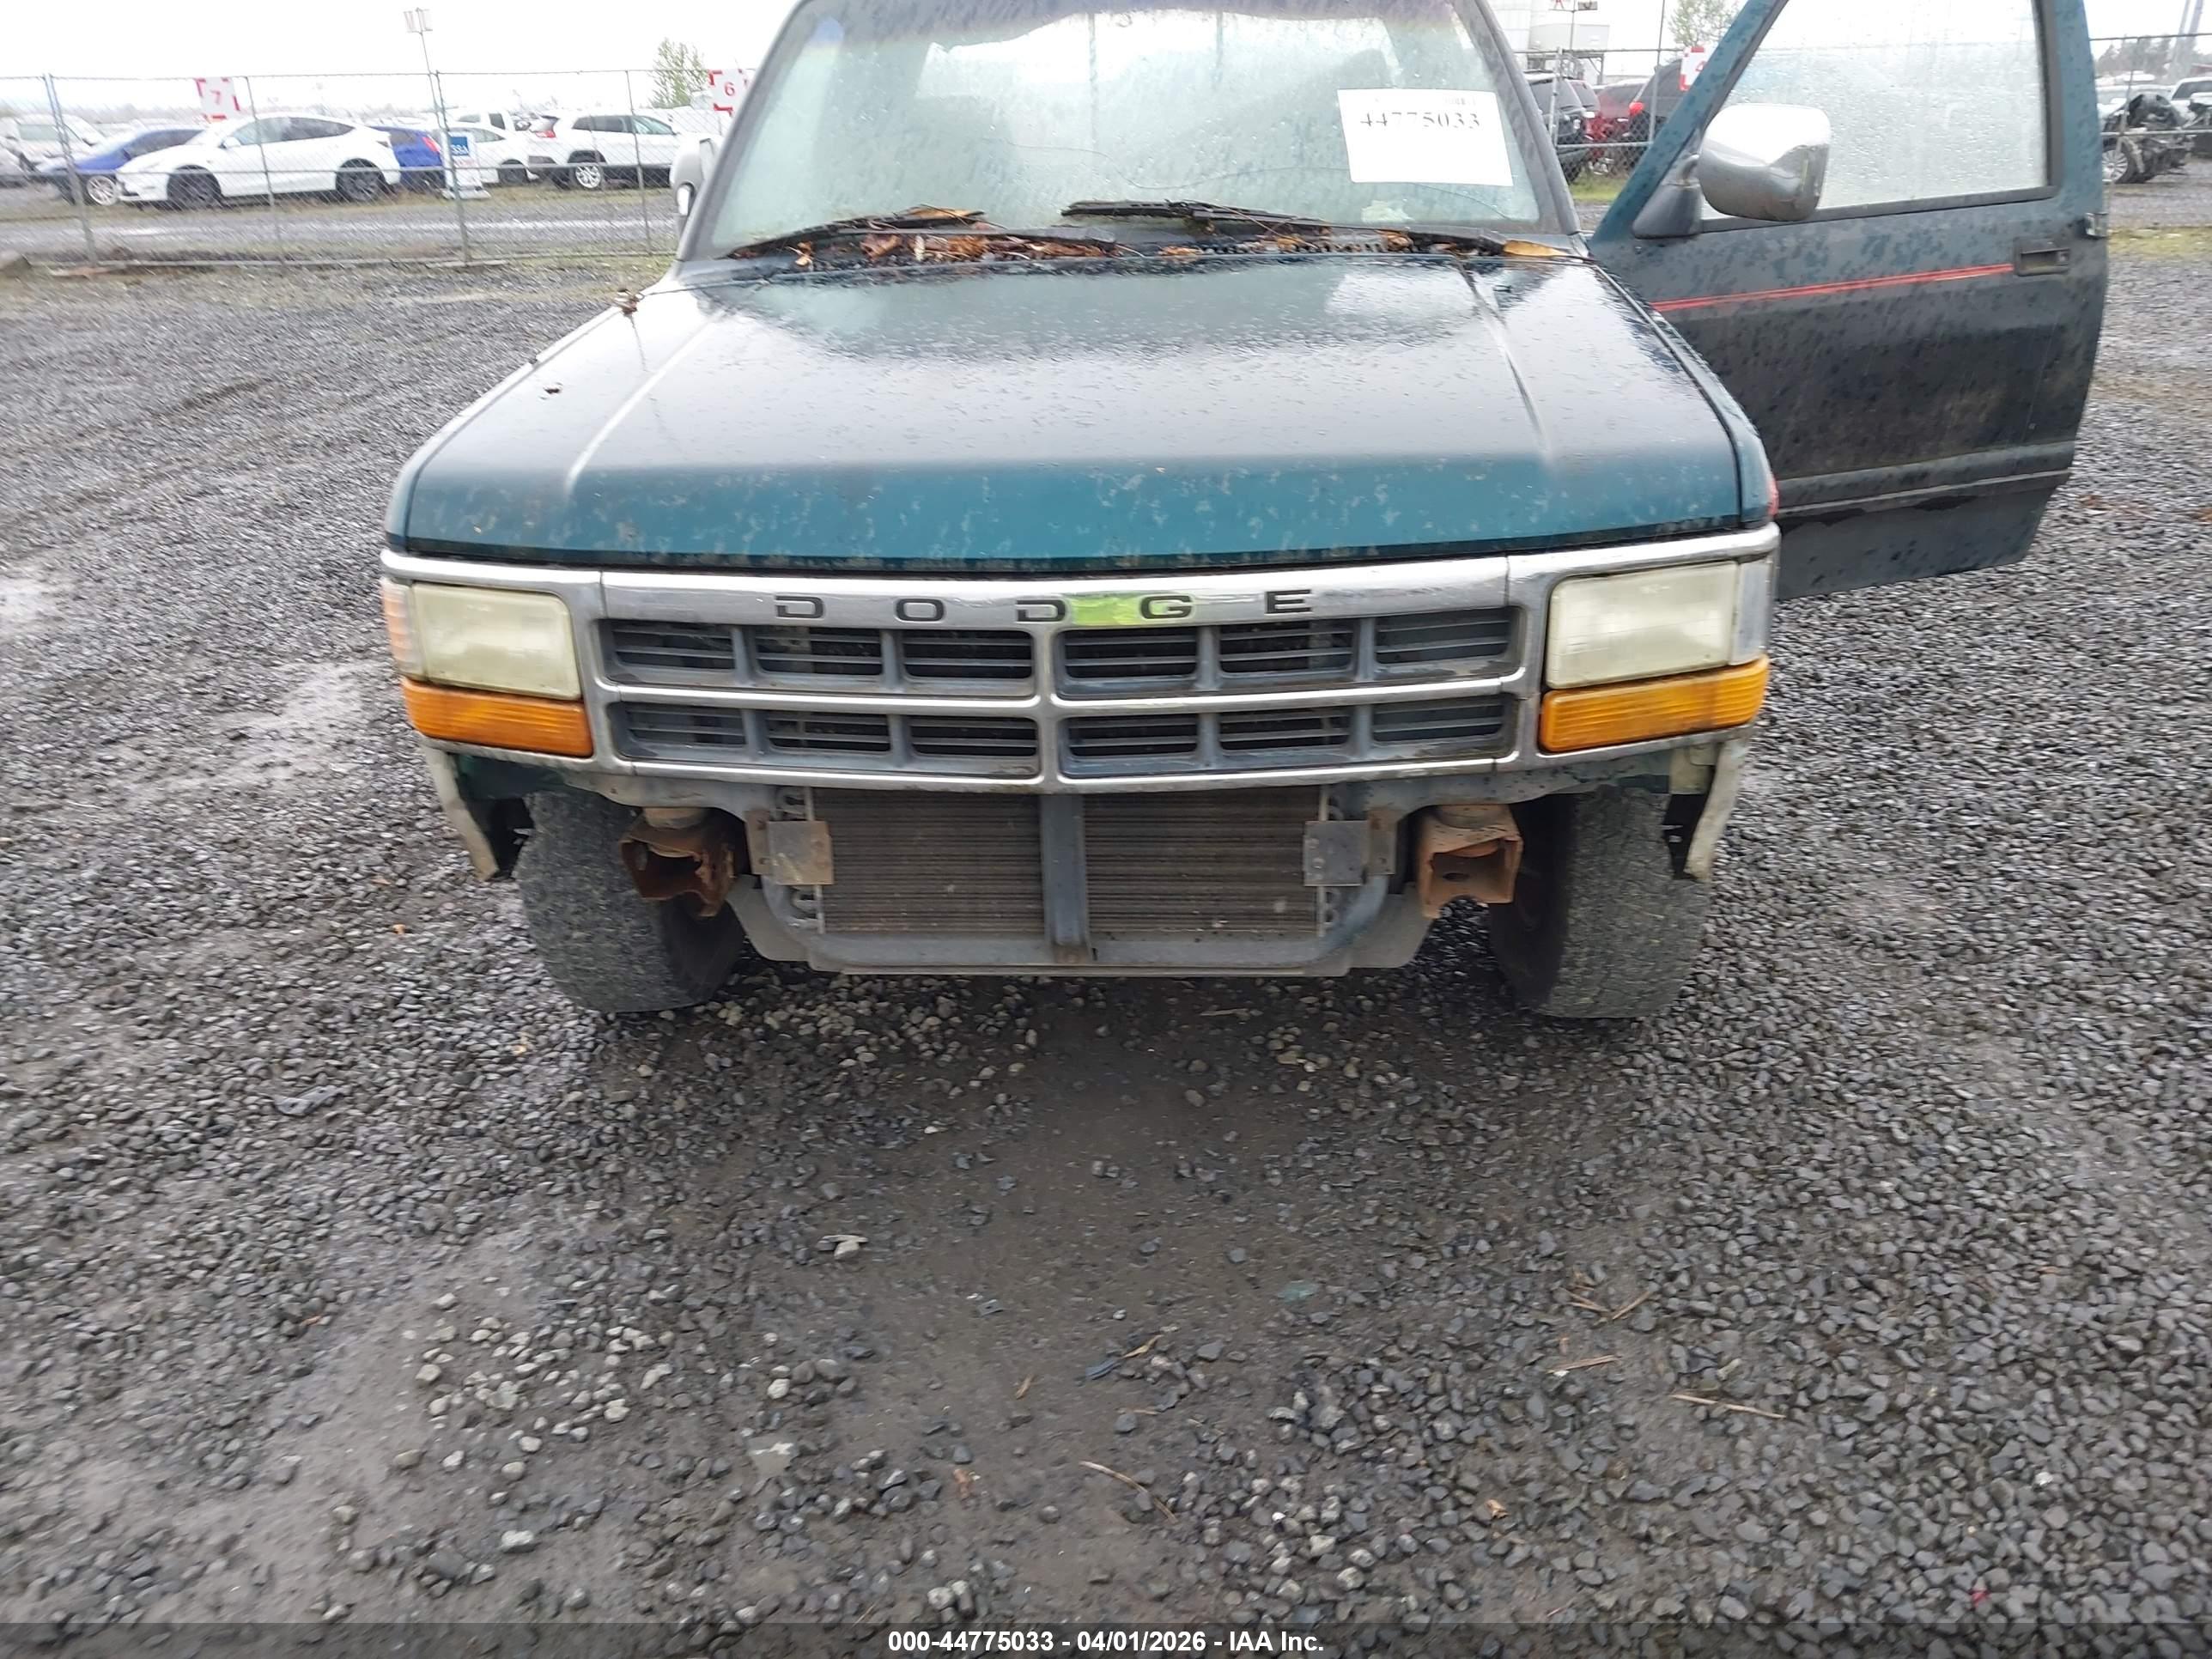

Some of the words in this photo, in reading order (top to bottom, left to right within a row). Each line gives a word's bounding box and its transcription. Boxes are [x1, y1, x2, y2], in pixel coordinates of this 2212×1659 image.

[209, 89, 222, 106] 7
[724, 82, 736, 97] 6
[775, 589, 1312, 623] DODGE
